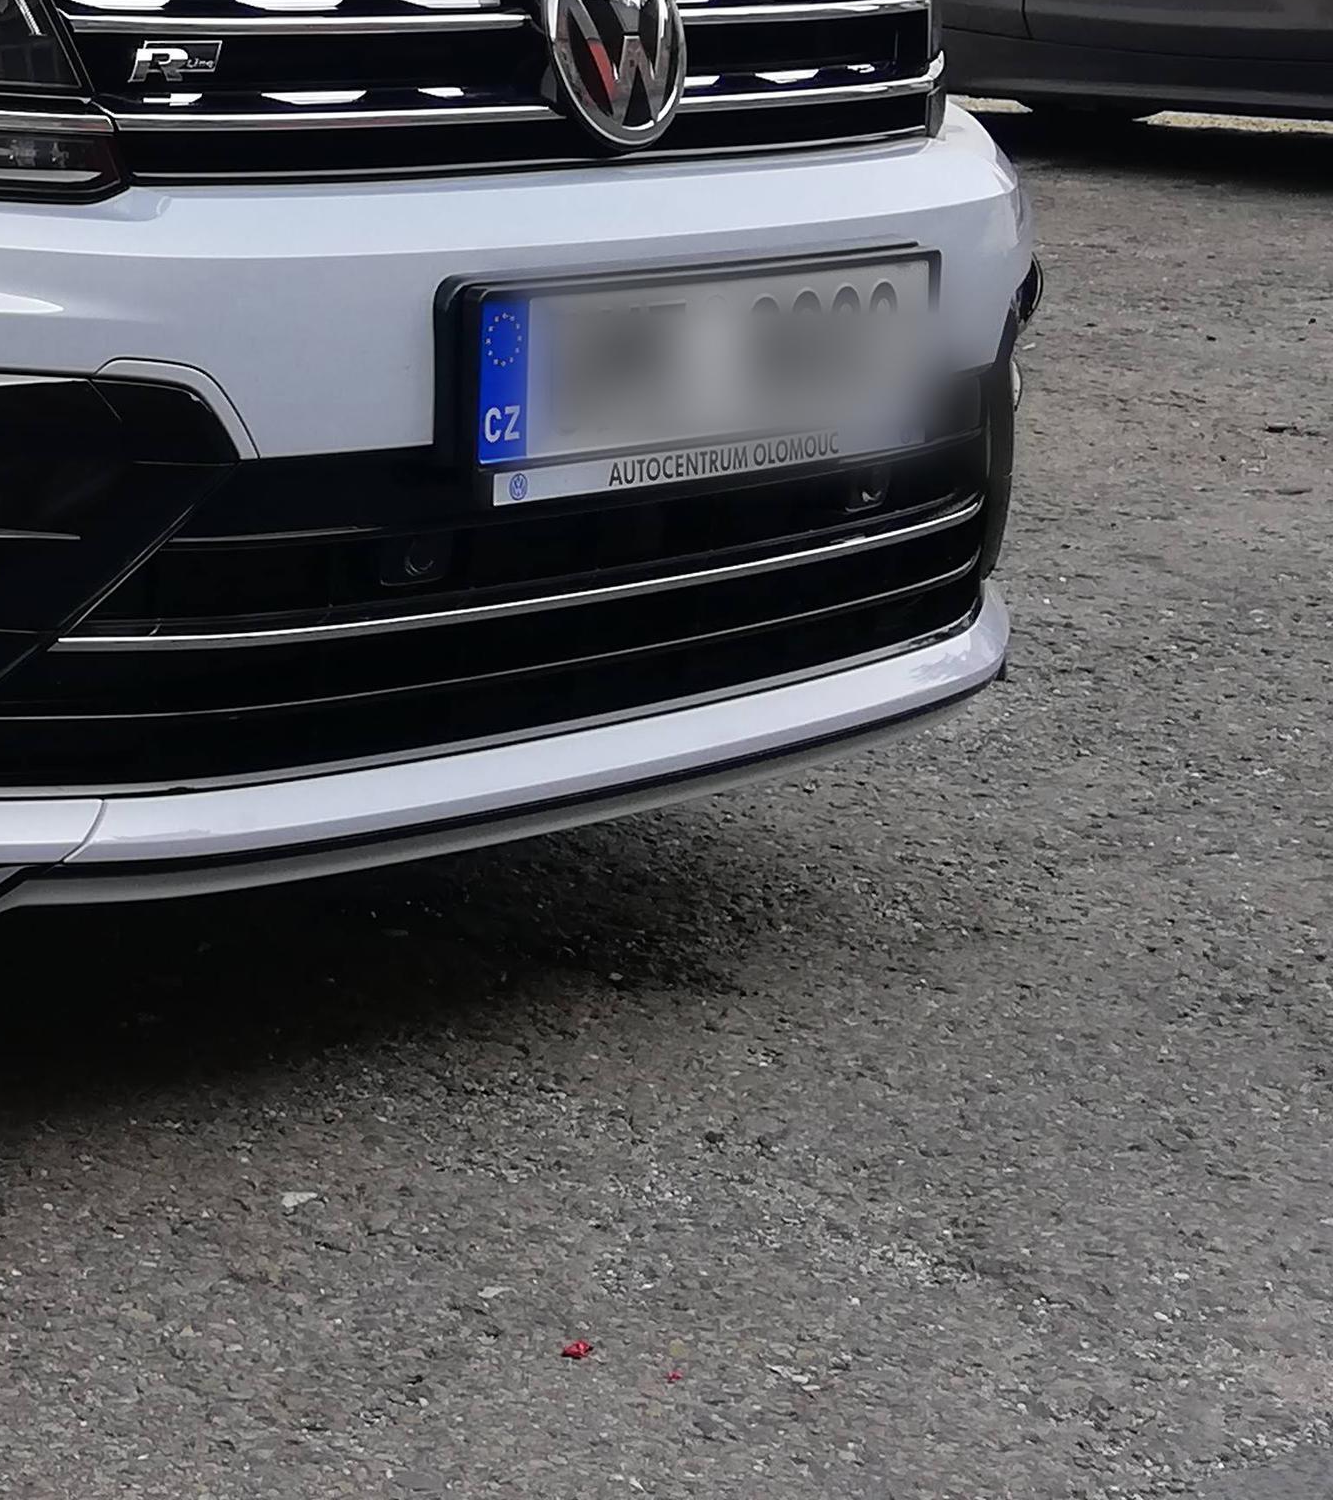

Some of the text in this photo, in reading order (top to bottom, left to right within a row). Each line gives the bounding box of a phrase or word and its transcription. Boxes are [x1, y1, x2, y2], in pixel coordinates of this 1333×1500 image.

[484, 405, 521, 443] CZ
[609, 432, 839, 487] AUTOCENTRUM OLOMOUC
